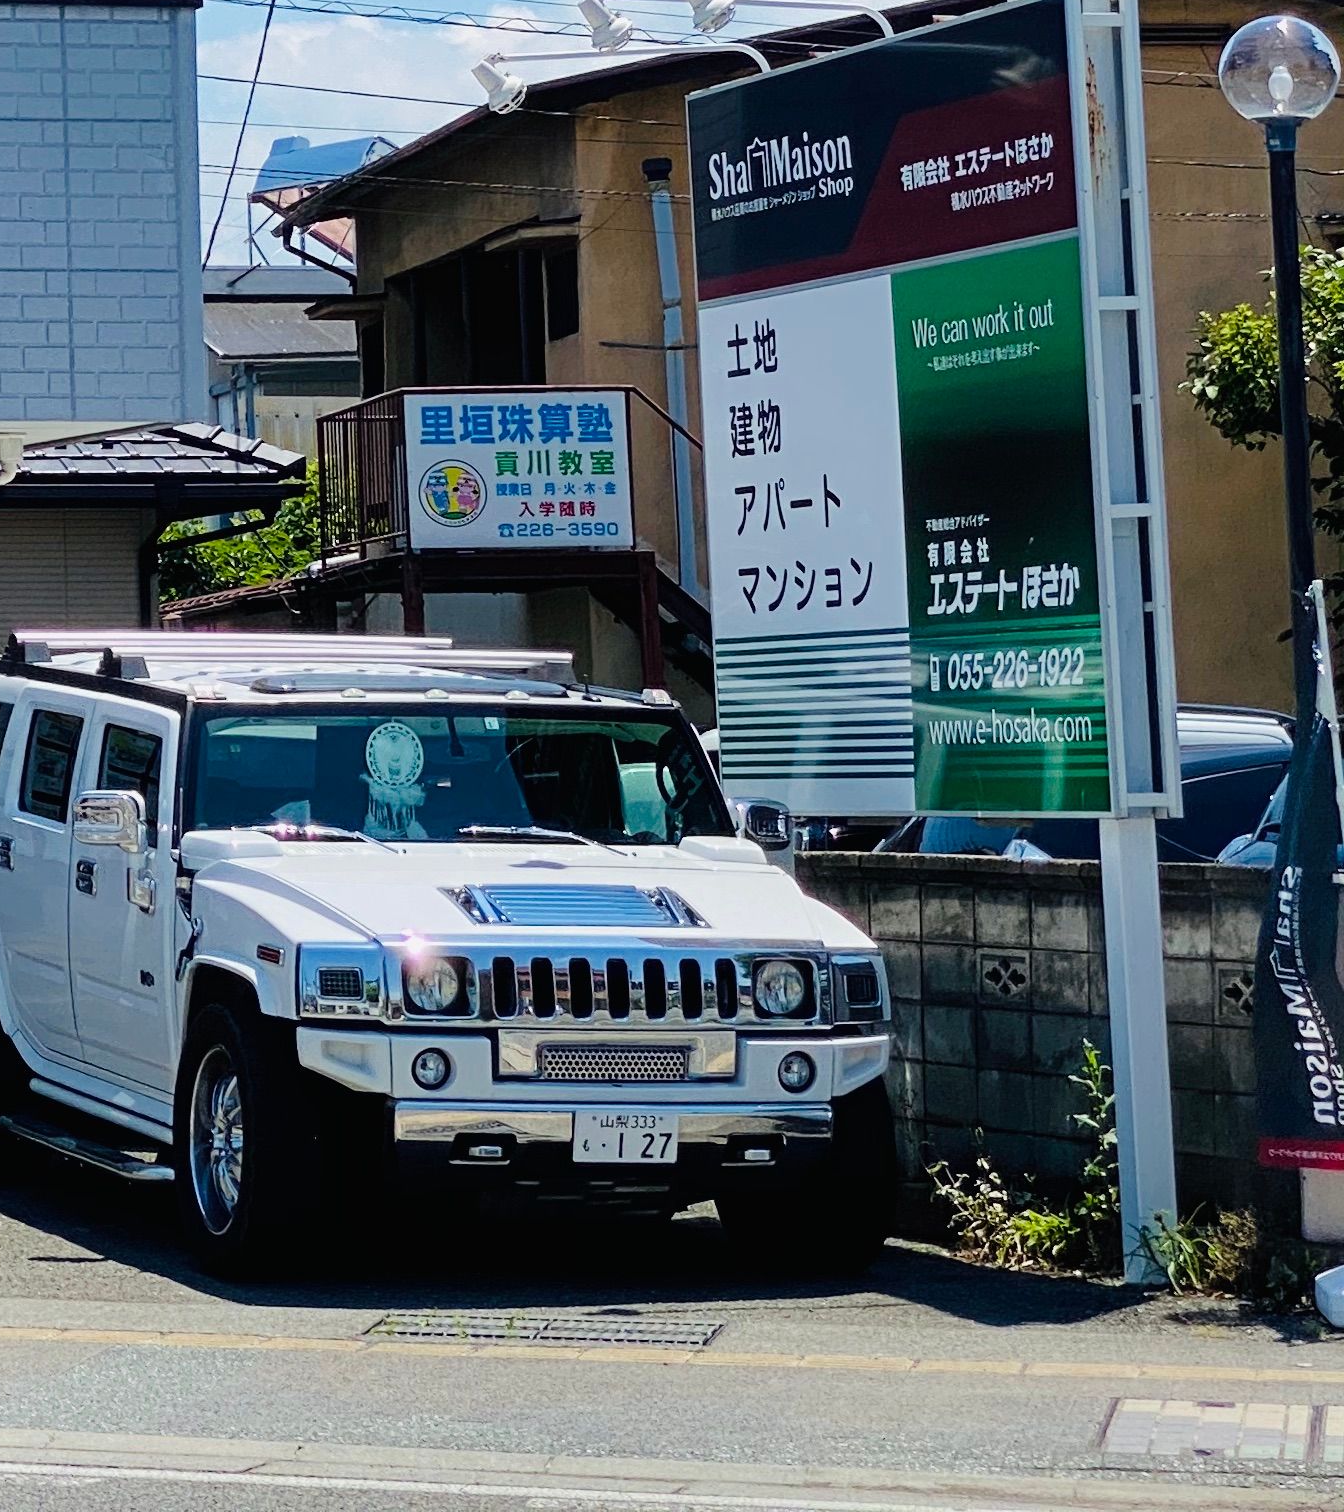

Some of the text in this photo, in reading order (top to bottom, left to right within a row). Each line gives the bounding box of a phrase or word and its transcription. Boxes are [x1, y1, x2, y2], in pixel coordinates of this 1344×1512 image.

[900, 132, 1054, 191] 有限会社 エステートほさか
[818, 176, 854, 198] Shop
[912, 298, 1054, 348] We can work it out
[727, 318, 779, 378] 土地
[420, 403, 613, 445] 里垣珠算塾
[729, 398, 782, 458] 建物
[495, 449, 615, 476] 貢川教室
[518, 501, 597, 517] 入学随時
[734, 473, 841, 536] アパート
[516, 522, 619, 537] 226-3590
[927, 537, 990, 567] 有限会社
[737, 557, 874, 614] マンション
[927, 563, 1080, 615] エステートほさか
[948, 646, 1085, 690] 055-226-1922
[928, 707, 1093, 745] www.e-hosaka.com
